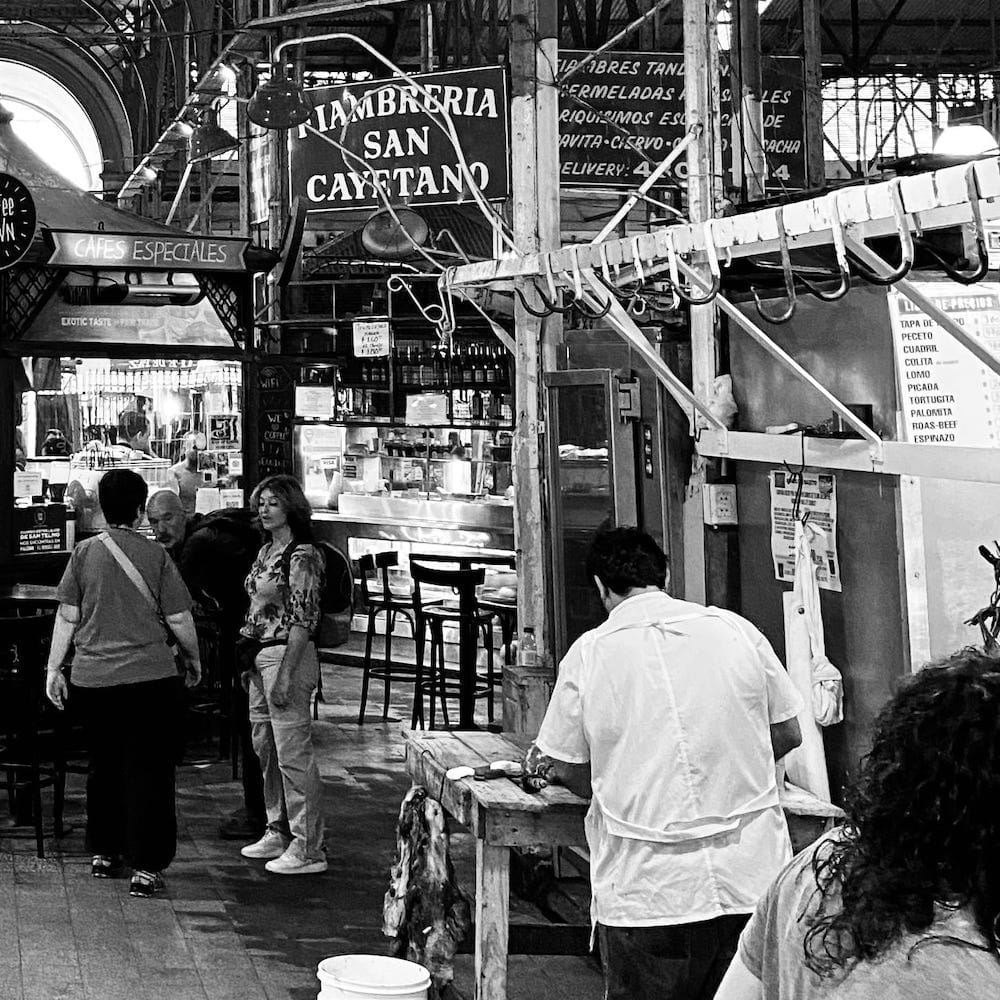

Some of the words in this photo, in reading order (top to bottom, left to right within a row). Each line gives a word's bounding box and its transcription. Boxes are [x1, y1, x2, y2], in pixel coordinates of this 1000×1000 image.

[763, 114, 785, 128] DE
[363, 126, 429, 159] SAN
[559, 161, 630, 177] ELIVERY:
[306, 161, 490, 203] CAYETANO
[132, 240, 227, 266] ESPECIALES
[61, 317, 88, 327] EXOTIC
[89, 317, 112, 327] TASTE
[900, 320, 920, 328] TAPA
[901, 332, 933, 341] PECETO
[903, 345, 938, 354] CUADRIL
[904, 357, 933, 366] COLITA
[906, 370, 931, 379] LOMO
[907, 383, 939, 392] PICADA
[909, 395, 955, 405] TORTUGITA
[910, 408, 953, 417] PALOMITA
[914, 433, 955, 443] ESPINAZO
